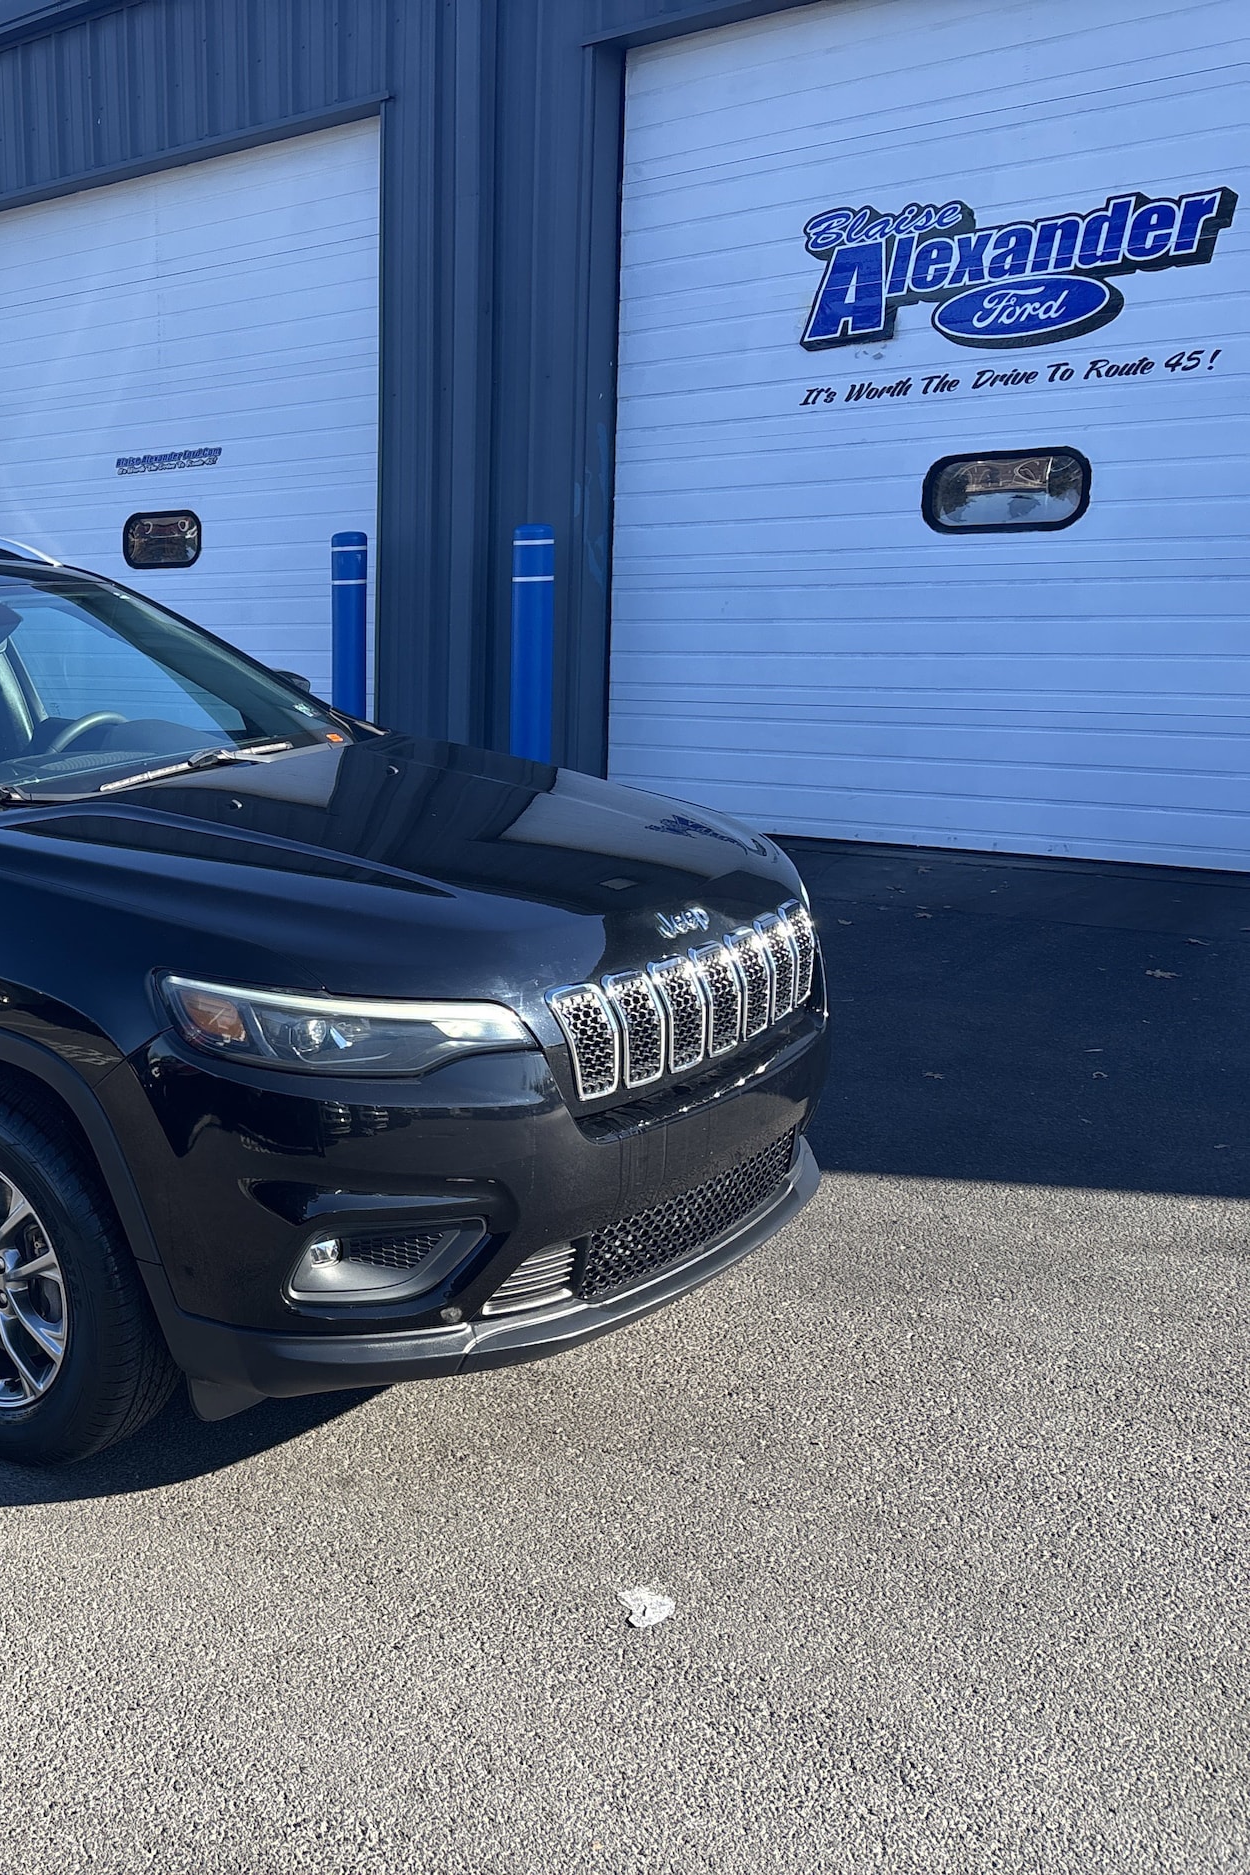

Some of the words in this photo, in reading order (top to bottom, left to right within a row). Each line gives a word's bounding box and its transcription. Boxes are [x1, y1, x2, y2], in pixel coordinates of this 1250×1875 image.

[806, 202, 963, 251] Blaise
[801, 189, 1229, 346] Alexander
[971, 284, 1068, 329] Ford
[799, 387, 837, 406] It's
[844, 377, 913, 402] Worth
[920, 373, 961, 395] The
[971, 368, 1039, 390] Drive
[1046, 361, 1075, 383] To
[1083, 356, 1155, 380] Route
[654, 906, 710, 939] Jeep
